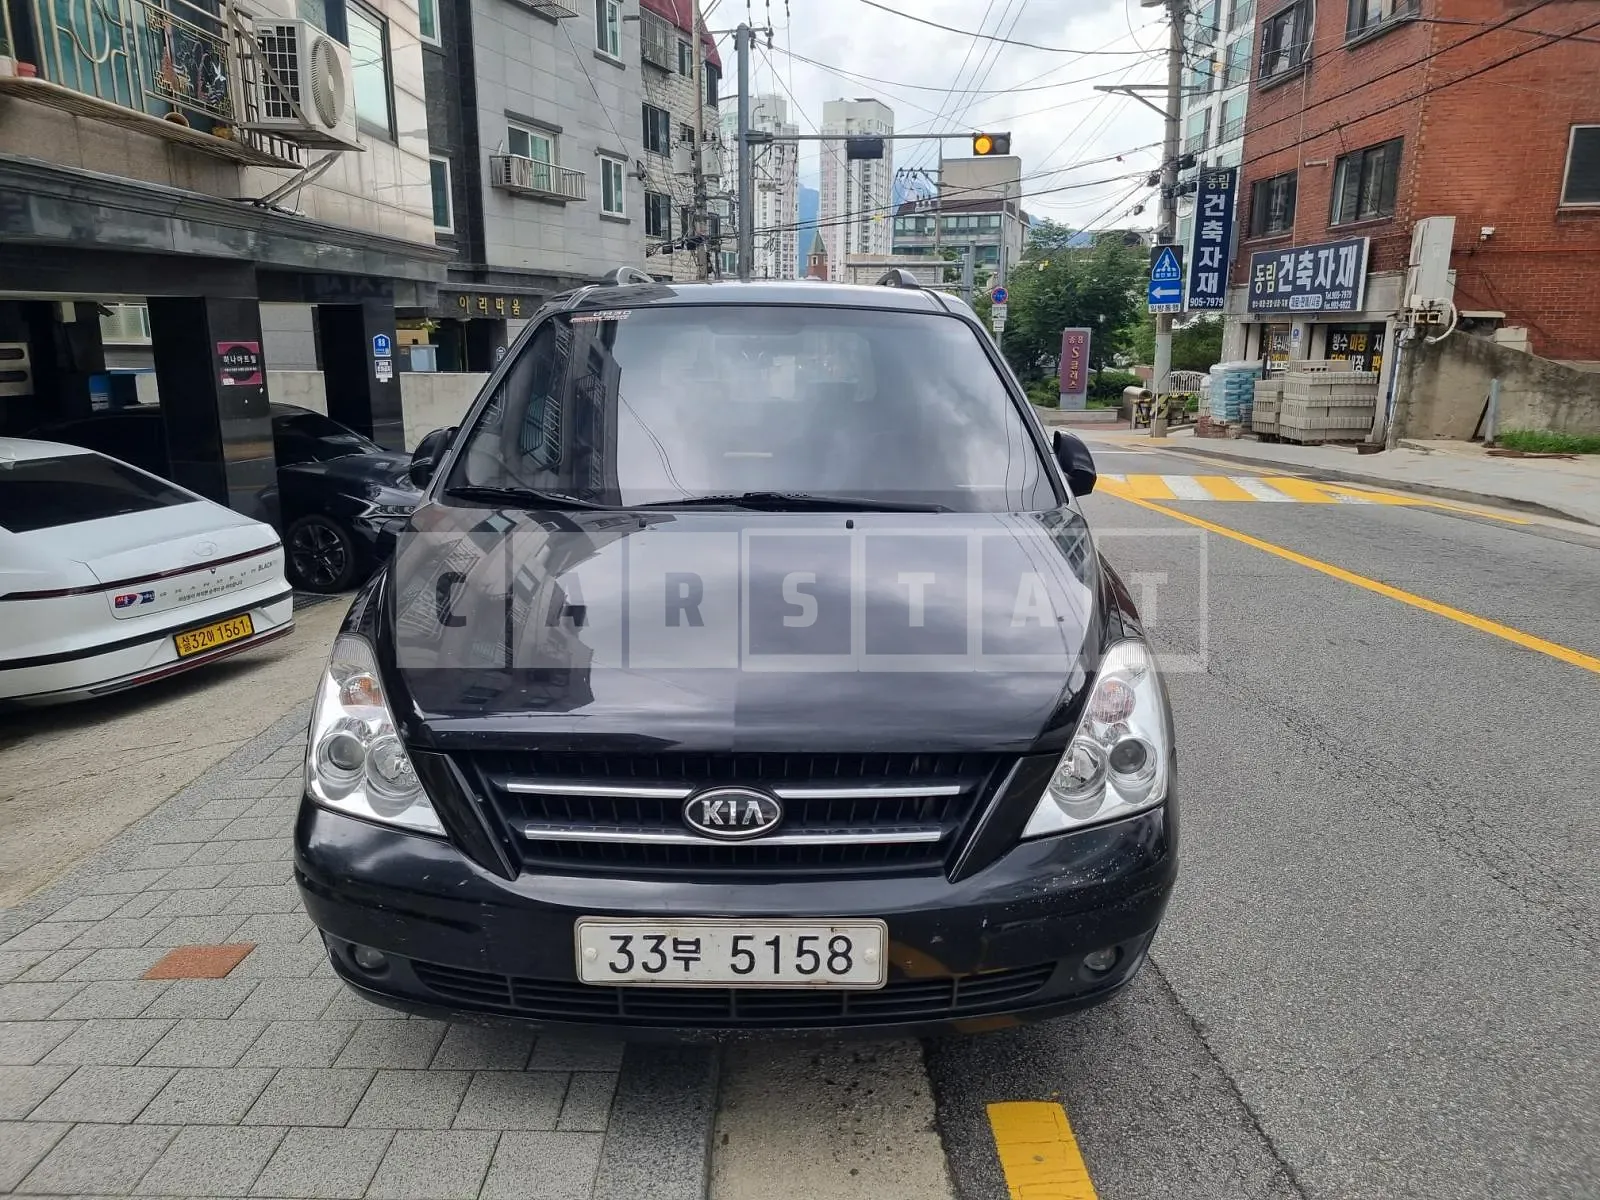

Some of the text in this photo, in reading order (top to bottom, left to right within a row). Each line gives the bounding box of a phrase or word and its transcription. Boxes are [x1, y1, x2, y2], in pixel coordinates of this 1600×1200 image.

[1197, 194, 1226, 294] 건축자재
[1255, 245, 1357, 293] 동림 건축자재
[1189, 297, 1224, 307] 905-7979
[217, 620, 247, 641] 1561
[702, 800, 766, 825] KIA
[608, 935, 853, 974] 33부 5158
